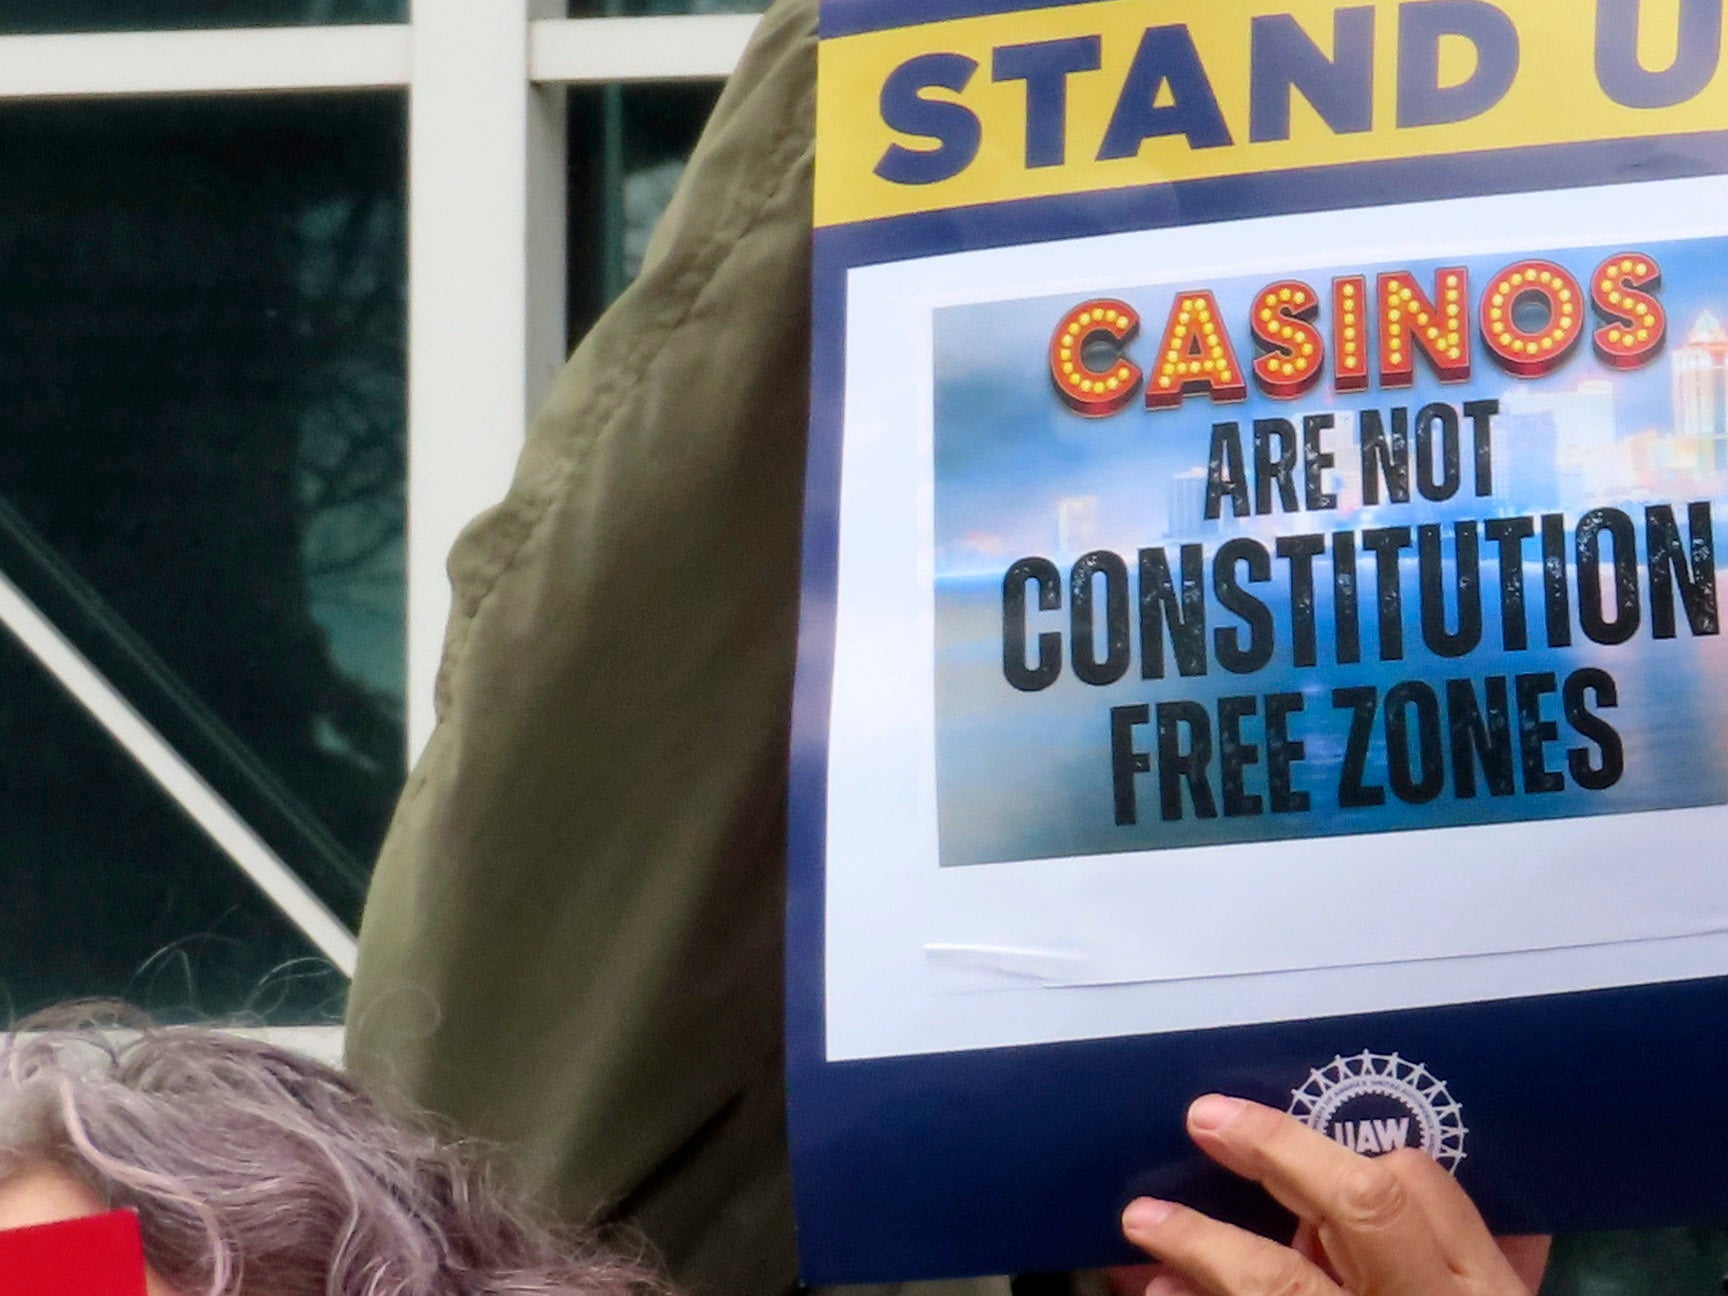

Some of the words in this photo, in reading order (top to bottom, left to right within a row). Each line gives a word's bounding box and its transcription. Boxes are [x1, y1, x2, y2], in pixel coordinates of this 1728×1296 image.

[1048, 250, 1668, 419] CASINOS
[1203, 411, 1337, 521] ARE
[1361, 399, 1500, 506] NOT
[999, 501, 1721, 693] CONSTITUTION
[1110, 689, 1311, 827] FREE
[1330, 668, 1626, 809] ZONES
[1334, 1117, 1410, 1154] UAW
